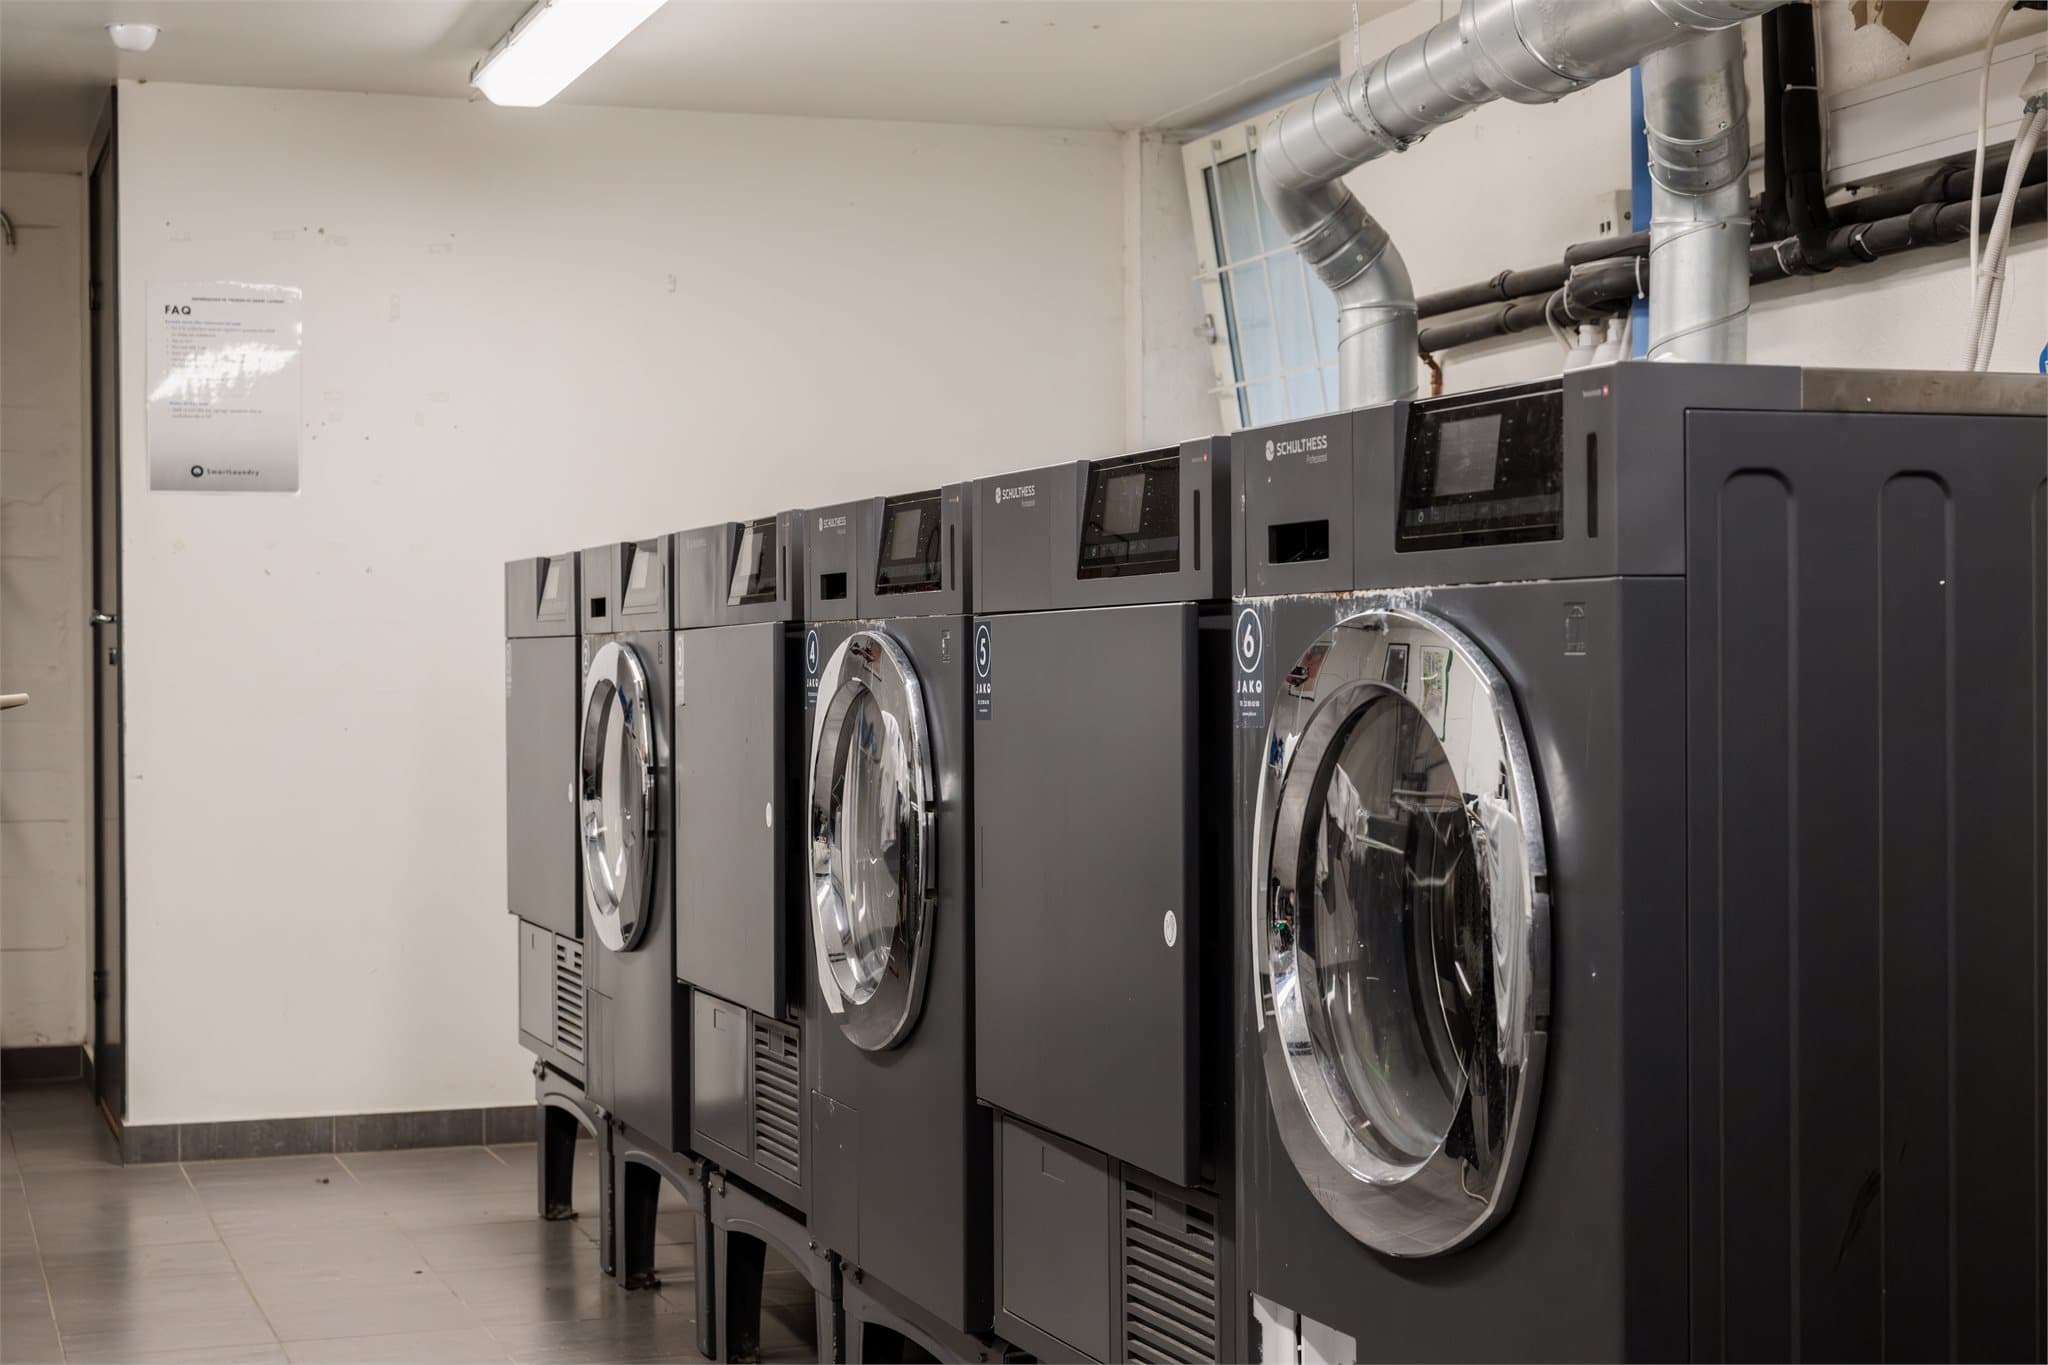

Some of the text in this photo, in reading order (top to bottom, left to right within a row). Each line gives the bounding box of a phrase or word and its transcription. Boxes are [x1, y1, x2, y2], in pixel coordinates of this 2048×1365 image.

[165, 304, 191, 315] FAQ
[1276, 434, 1328, 456] SCHULTHESS
[1002, 484, 1036, 500] SCHULTHESS
[809, 640, 816, 664] 4
[980, 638, 986, 665] 5
[1243, 623, 1255, 658] 6
